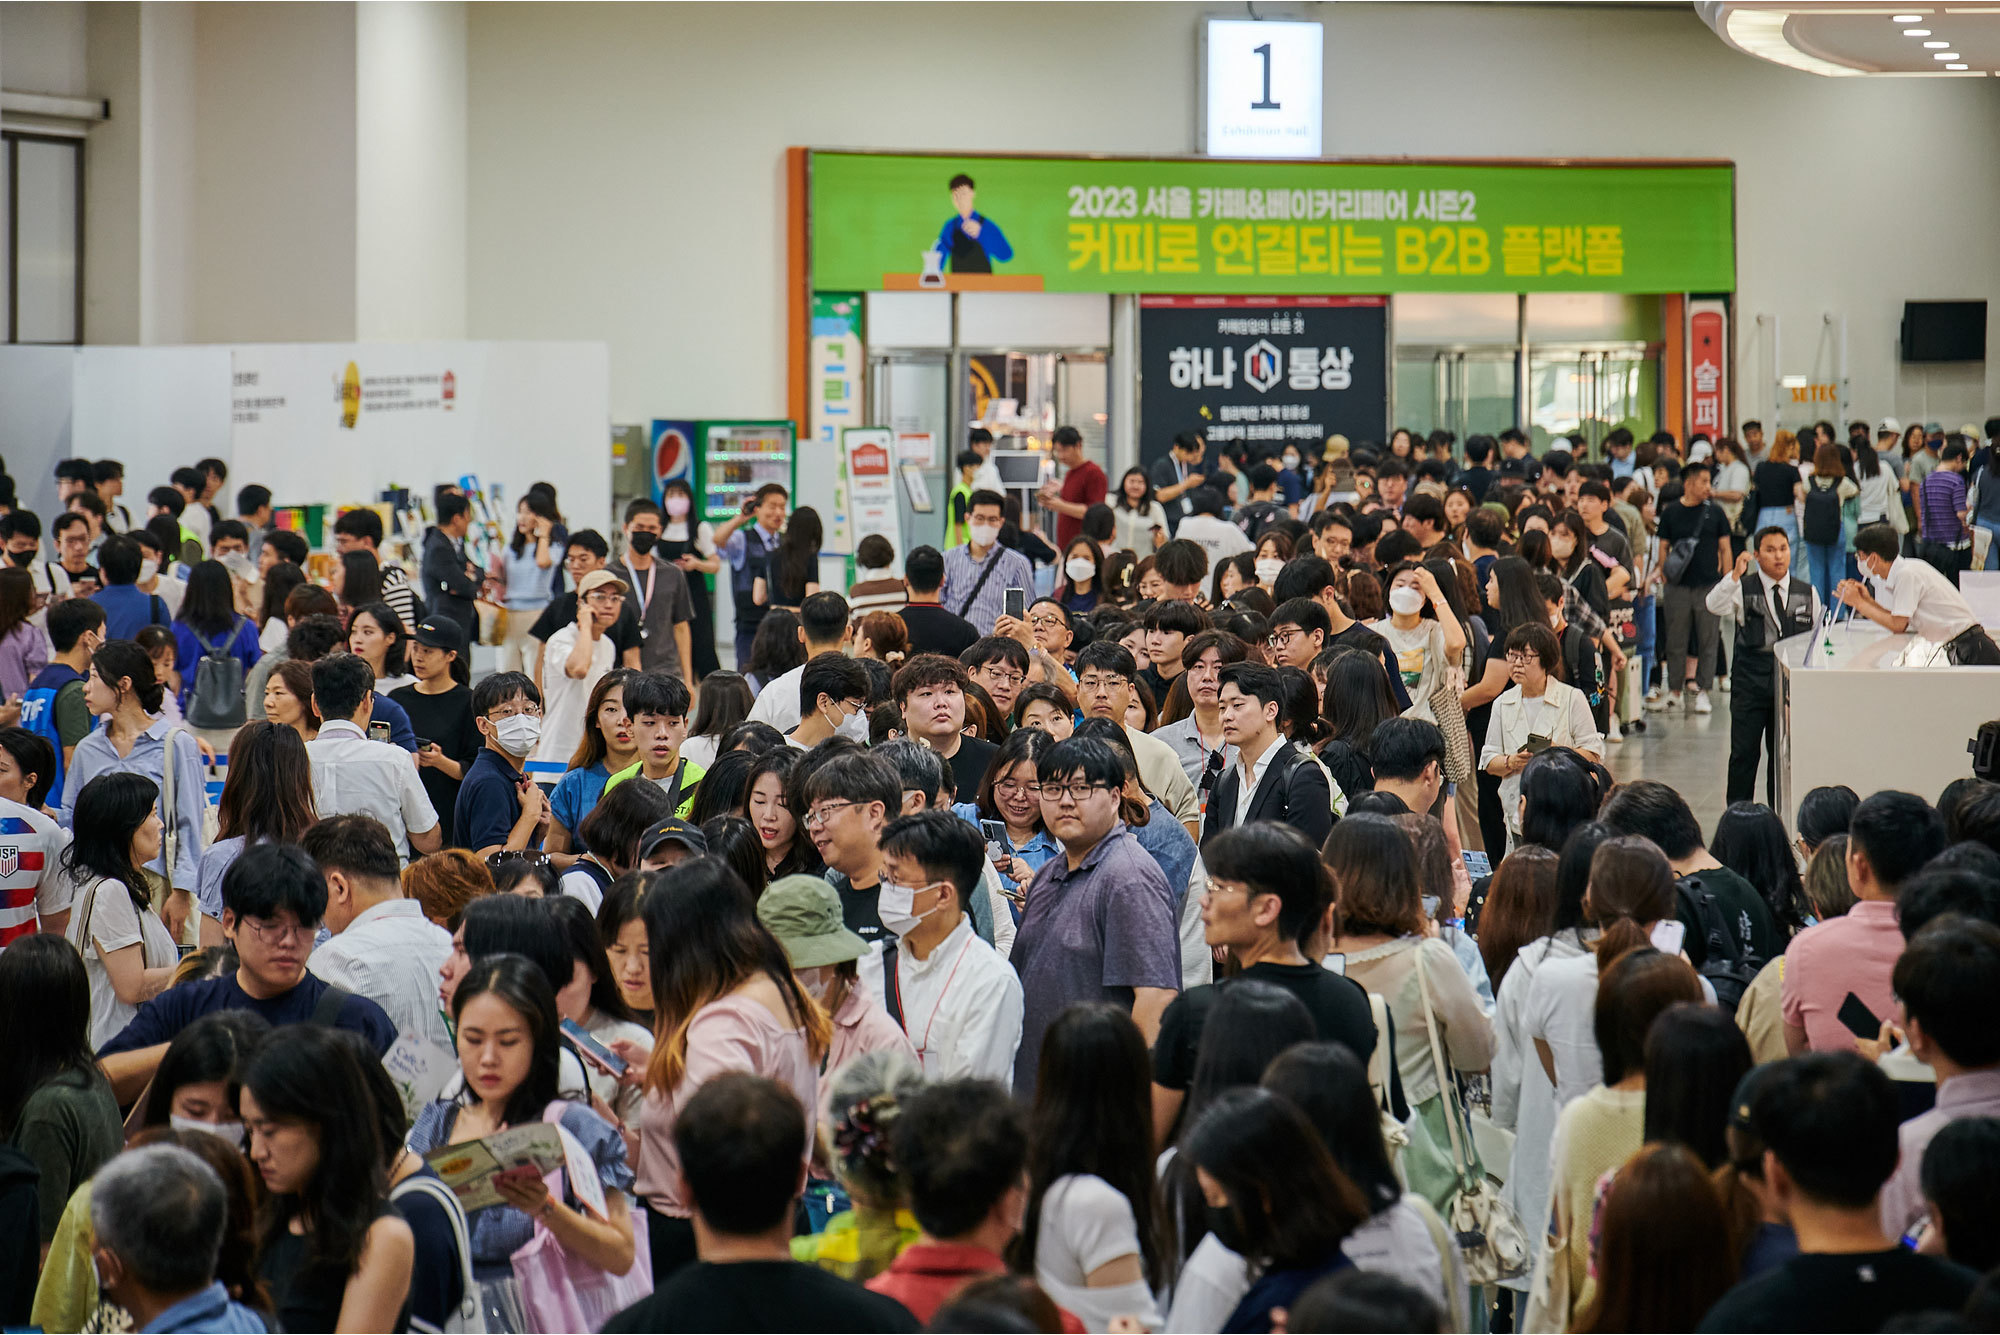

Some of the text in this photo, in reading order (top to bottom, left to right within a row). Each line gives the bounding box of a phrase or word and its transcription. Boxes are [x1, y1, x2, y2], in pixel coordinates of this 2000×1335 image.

[1251, 42, 1281, 110] 1
[1068, 185, 1477, 222] 2023 서울 카페&베이커리페어 시즌2
[1067, 222, 1624, 277] 커피로 연결되는 B2B 플랫폼
[1169, 346, 1354, 391] 하나 통상
[0, 848, 16, 859] SA
